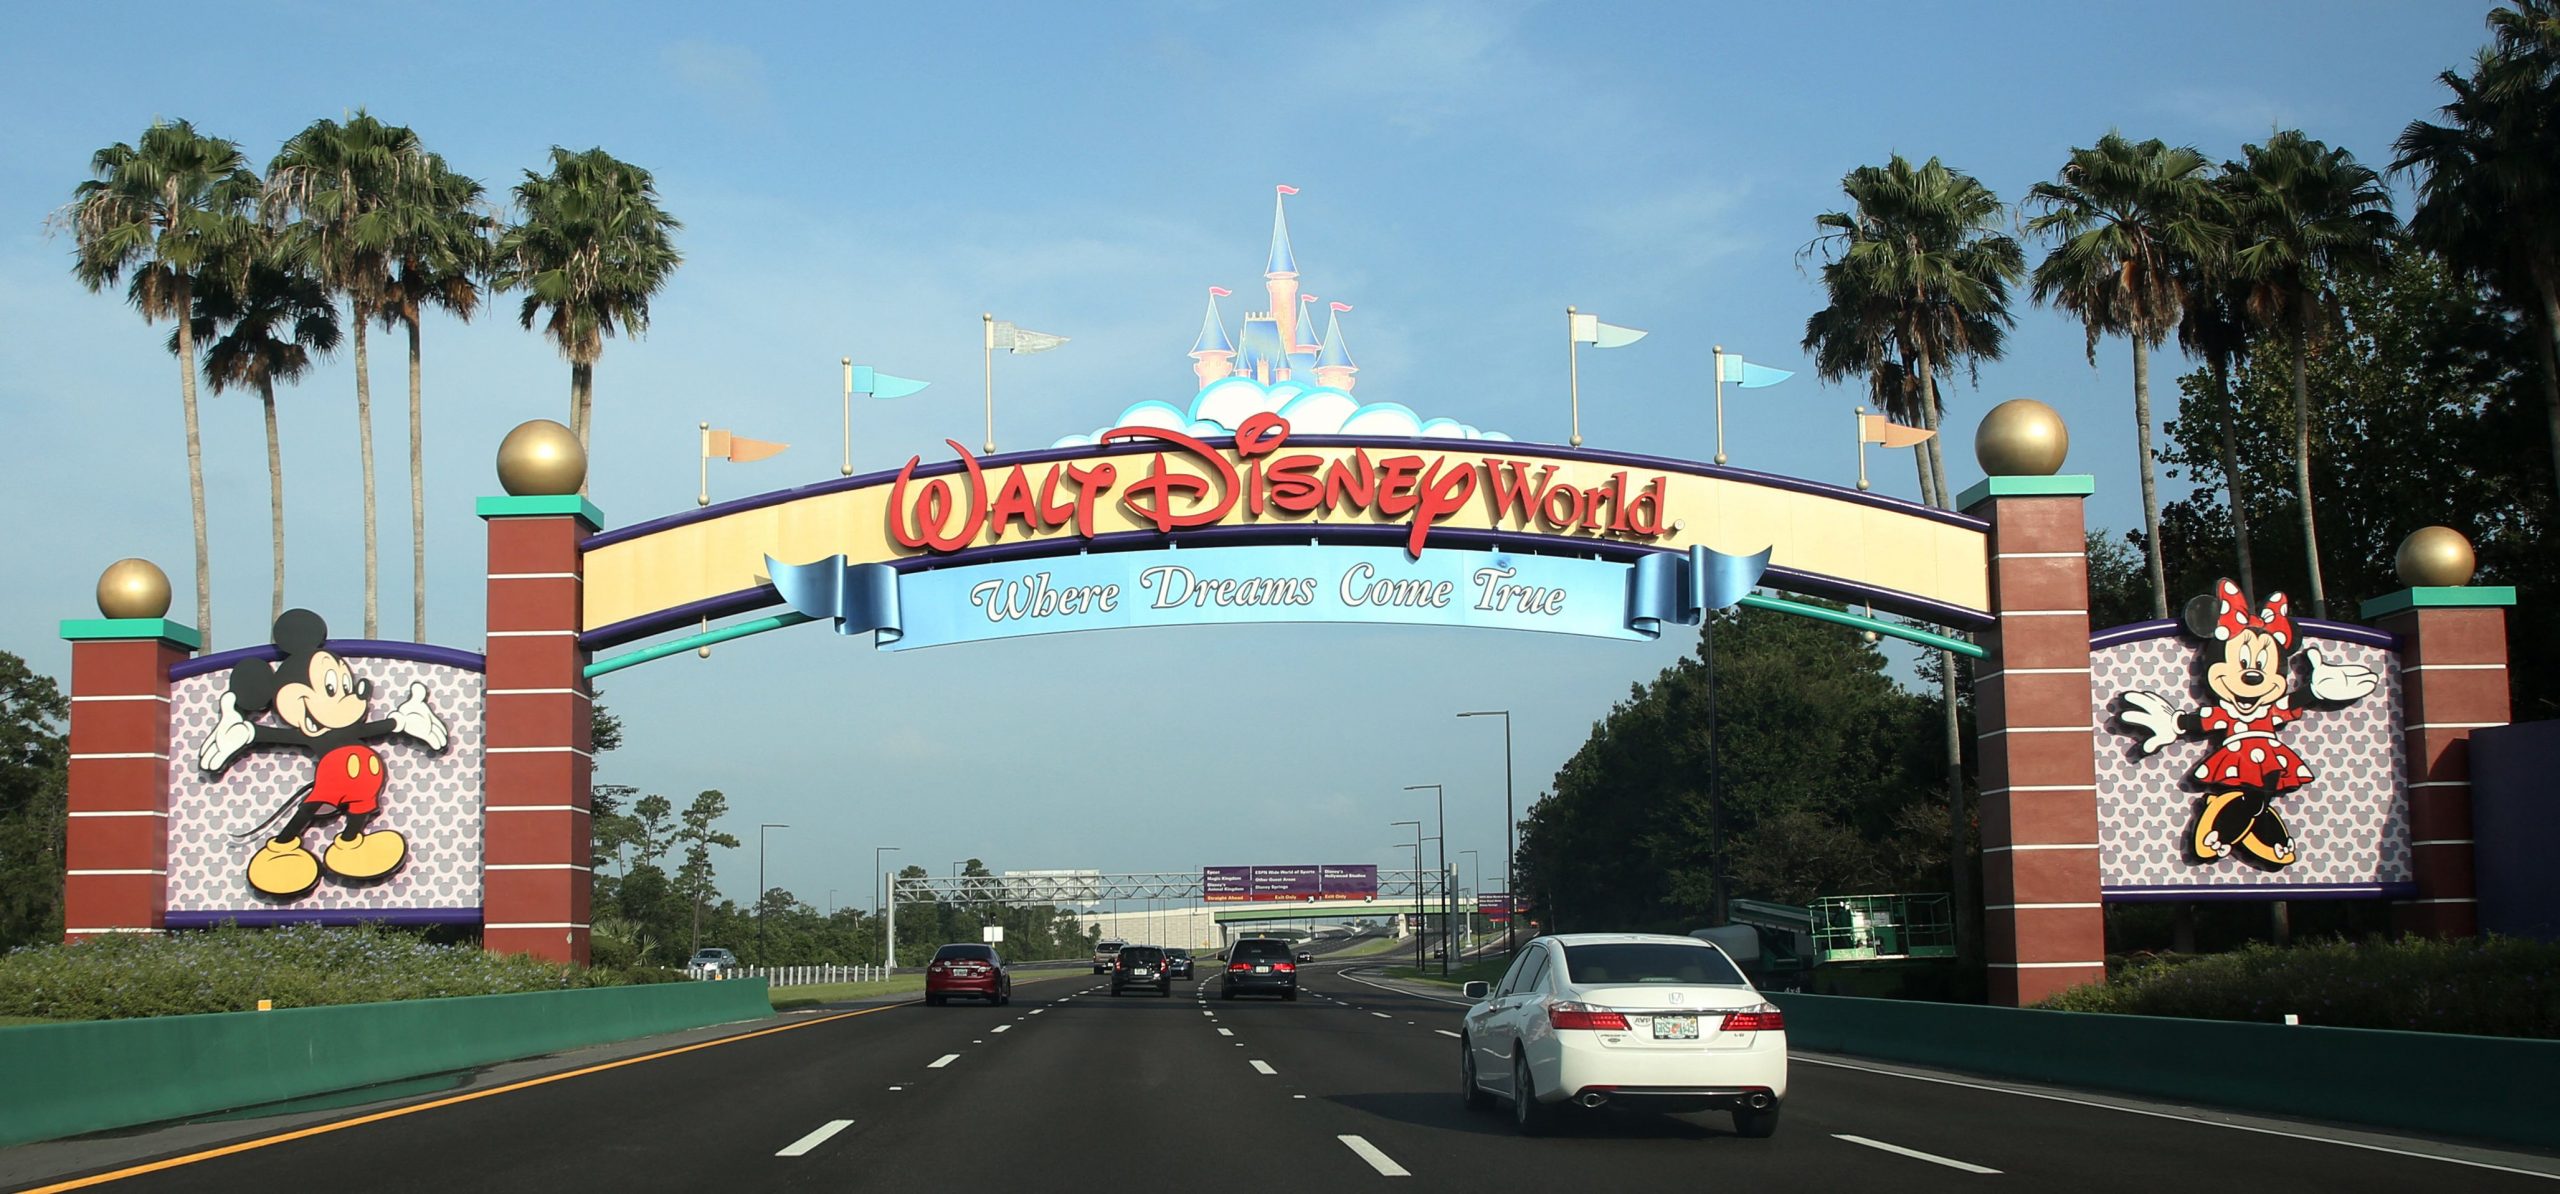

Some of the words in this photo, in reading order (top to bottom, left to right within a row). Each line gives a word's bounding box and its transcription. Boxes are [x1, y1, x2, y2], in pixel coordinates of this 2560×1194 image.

[1481, 457, 1668, 538] World
[970, 571, 1119, 622] Where
[1139, 564, 1316, 610] Dreams
[1338, 563, 1453, 609] Come
[1473, 565, 1568, 616] True
